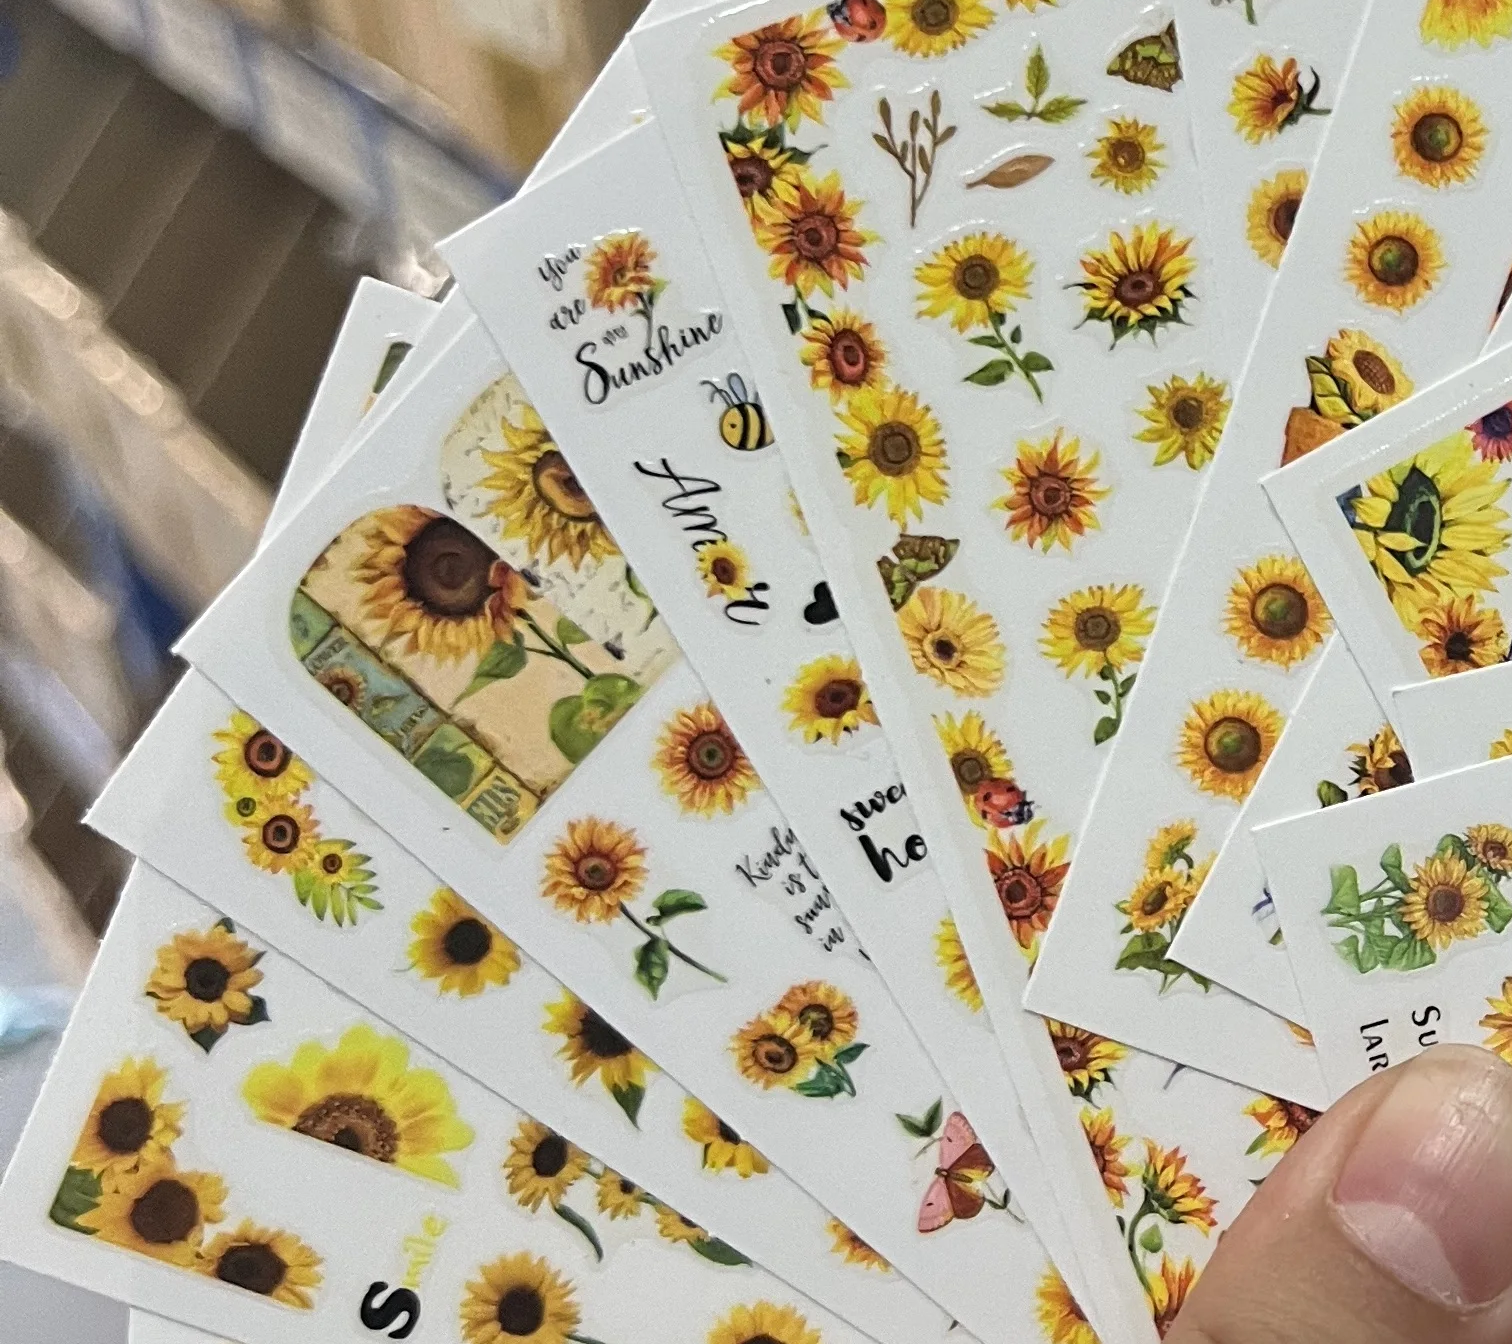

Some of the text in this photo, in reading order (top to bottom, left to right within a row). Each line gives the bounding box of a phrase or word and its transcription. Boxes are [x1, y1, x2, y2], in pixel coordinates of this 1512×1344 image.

[550, 298, 587, 331] are
[575, 312, 723, 405] Sunshine
[840, 782, 907, 832] swe
